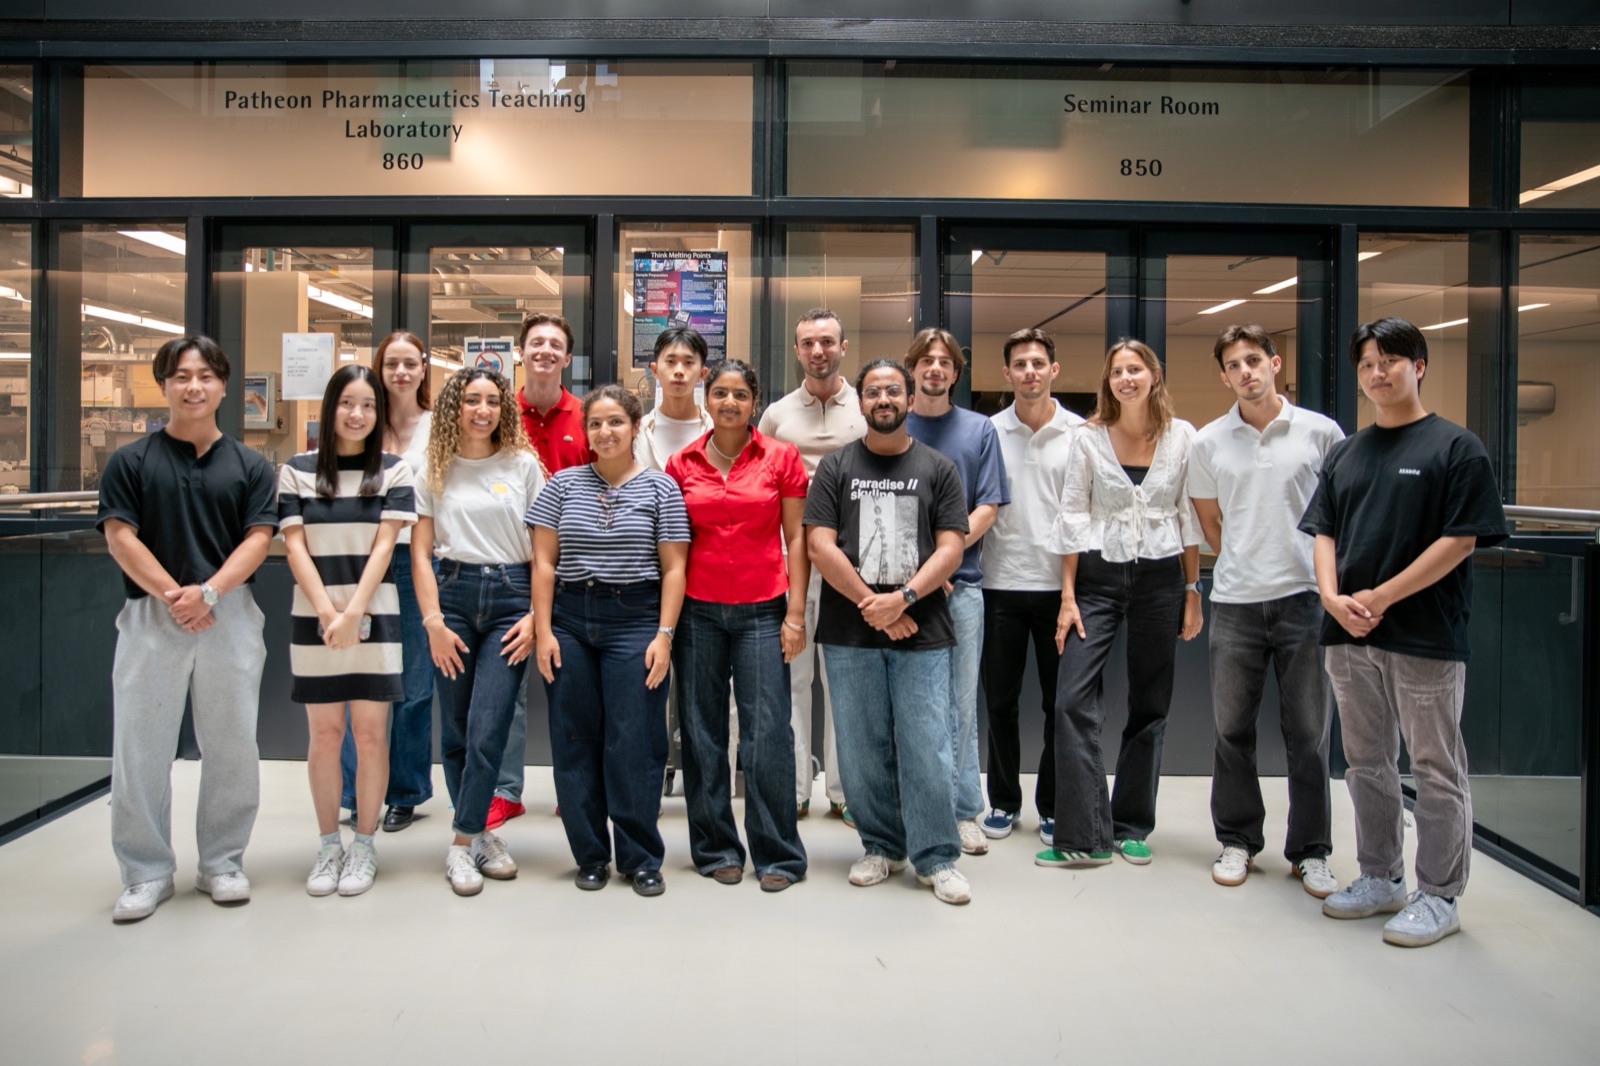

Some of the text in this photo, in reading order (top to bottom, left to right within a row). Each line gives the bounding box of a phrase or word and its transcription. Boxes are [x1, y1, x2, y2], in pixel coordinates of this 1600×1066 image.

[225, 89, 586, 113] Patheon Pharmaceutics Teaching
[1063, 94, 1220, 115] Seminar Room
[345, 119, 463, 142] Laboratory
[382, 152, 424, 170] 860
[1120, 159, 1163, 176] 850
[851, 478, 918, 490] Paradise //
